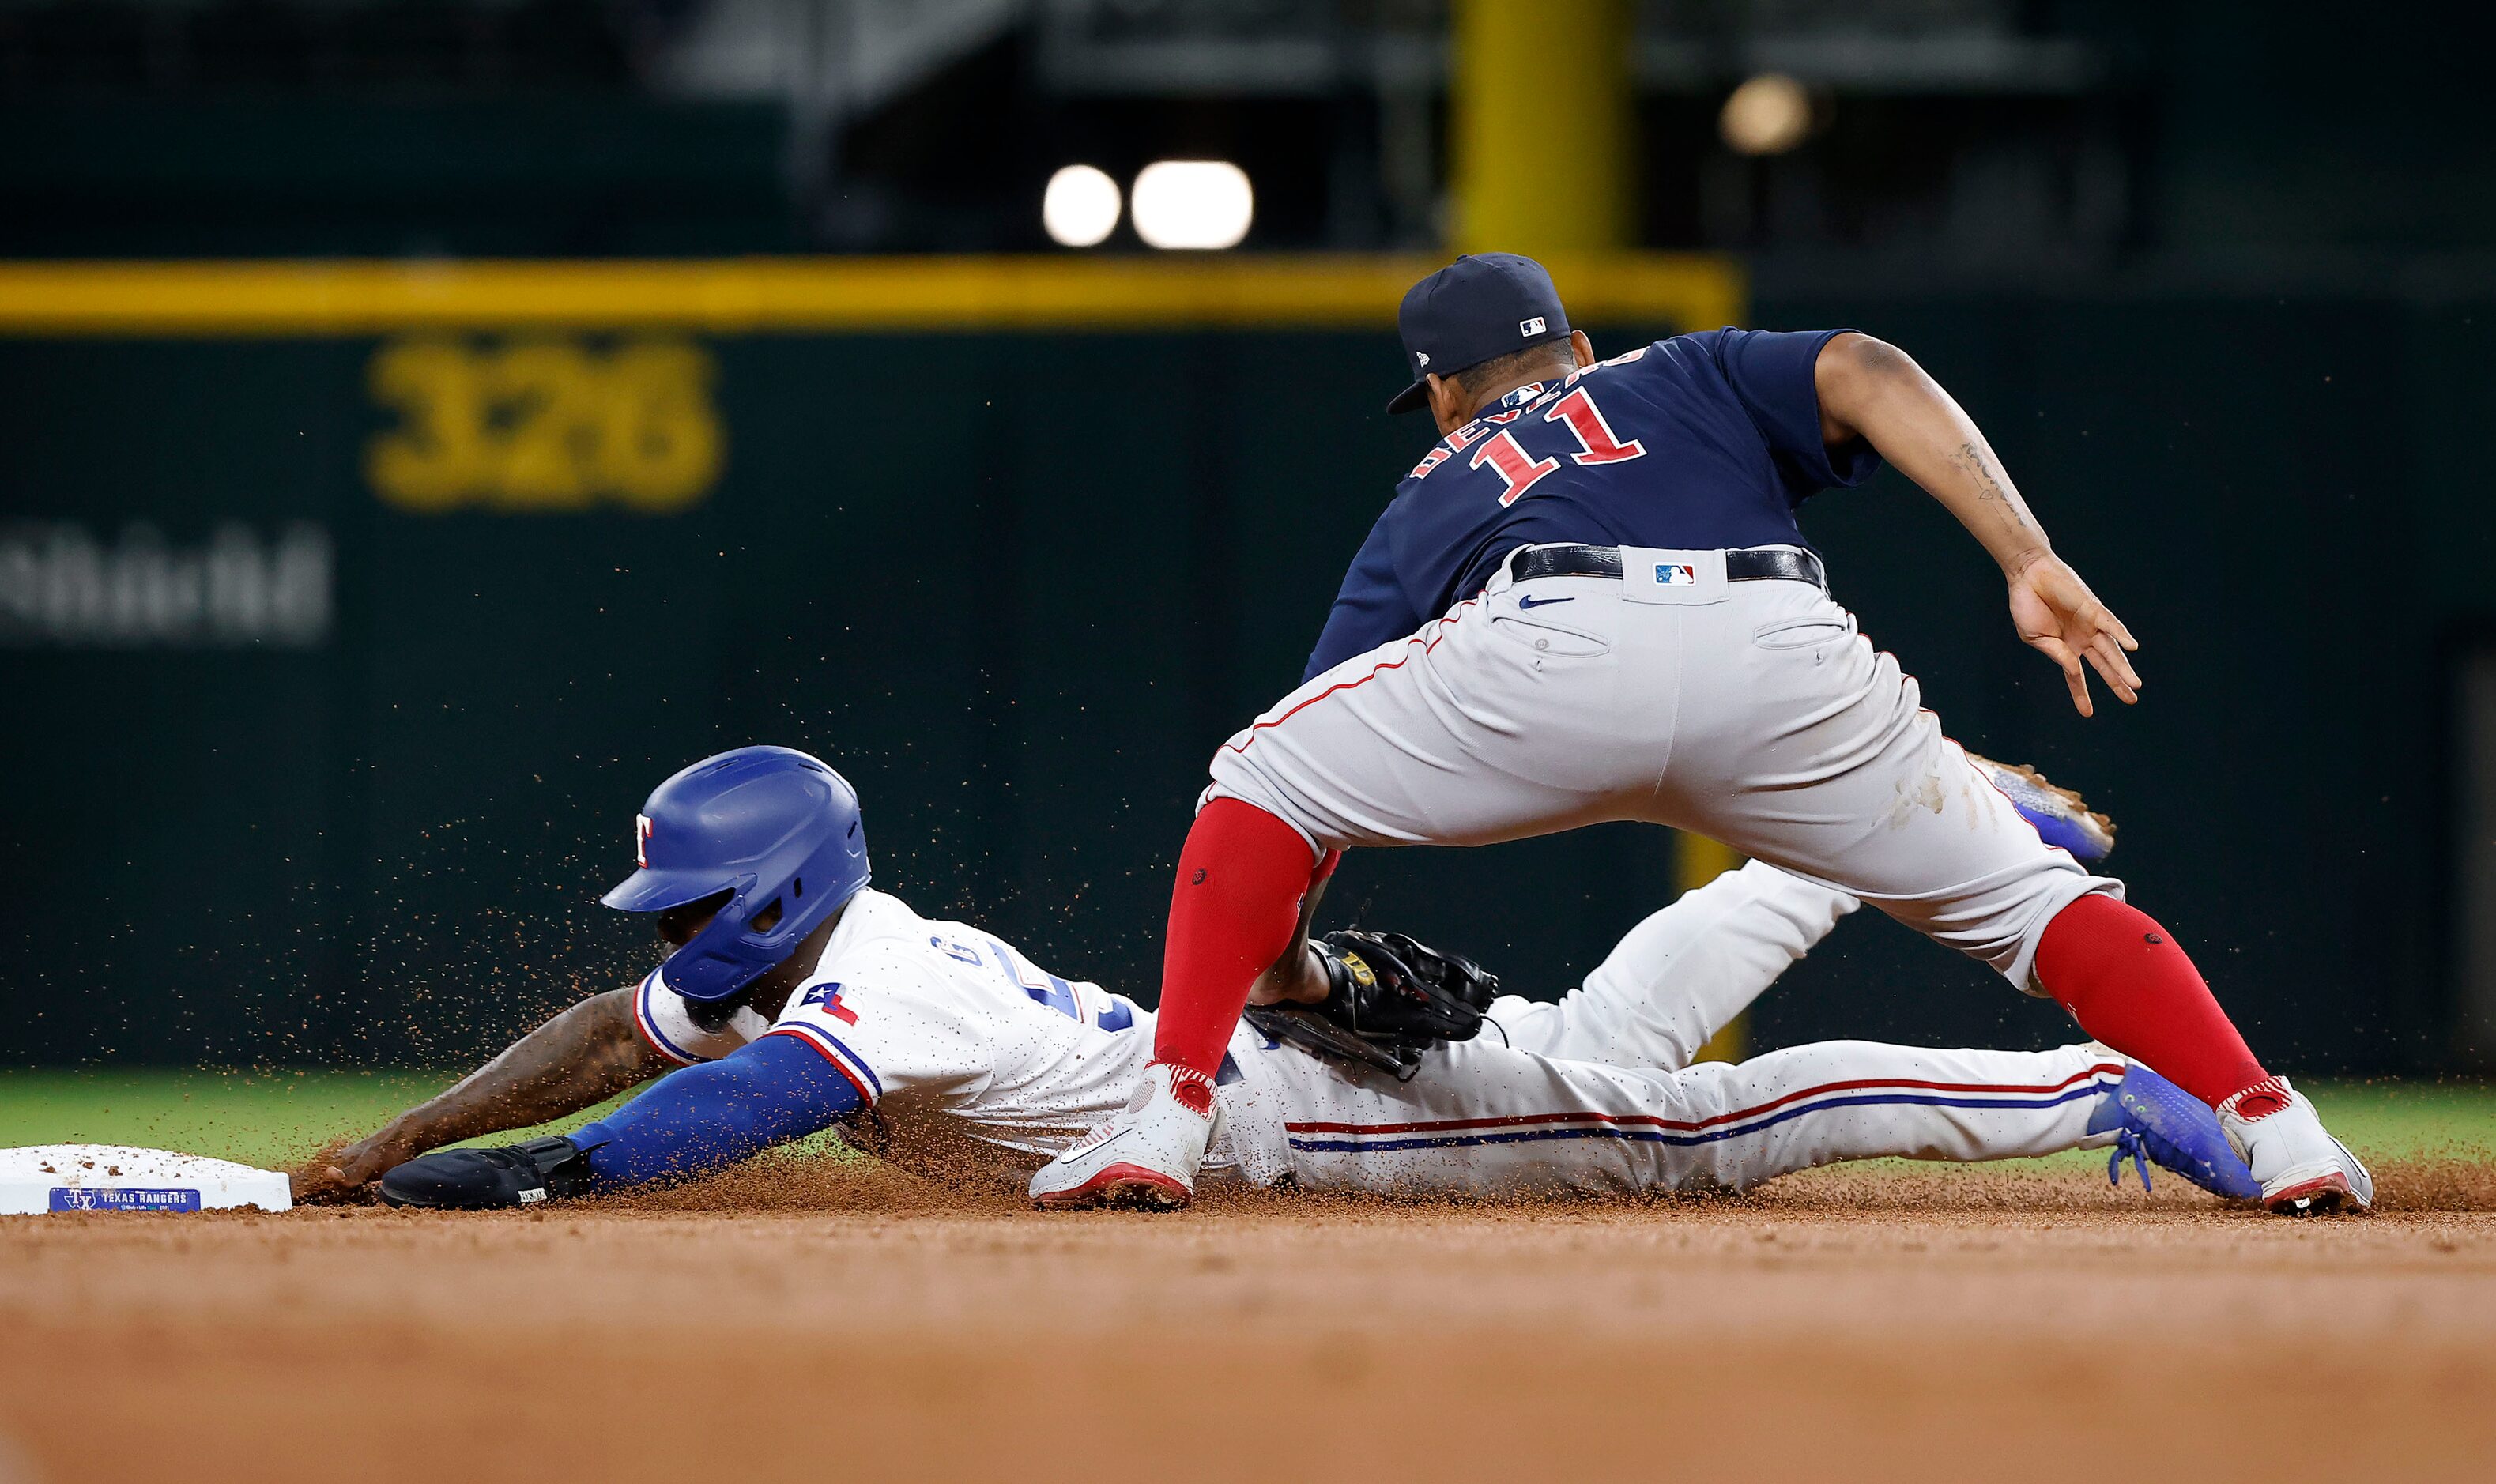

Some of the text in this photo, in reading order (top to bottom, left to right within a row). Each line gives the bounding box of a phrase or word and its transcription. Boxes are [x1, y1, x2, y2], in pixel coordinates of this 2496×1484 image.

[368, 345, 721, 510] 326
[1468, 385, 1648, 509] 11
[636, 813, 654, 869] T
[103, 1192, 187, 1203] TEXAS RANGERS
